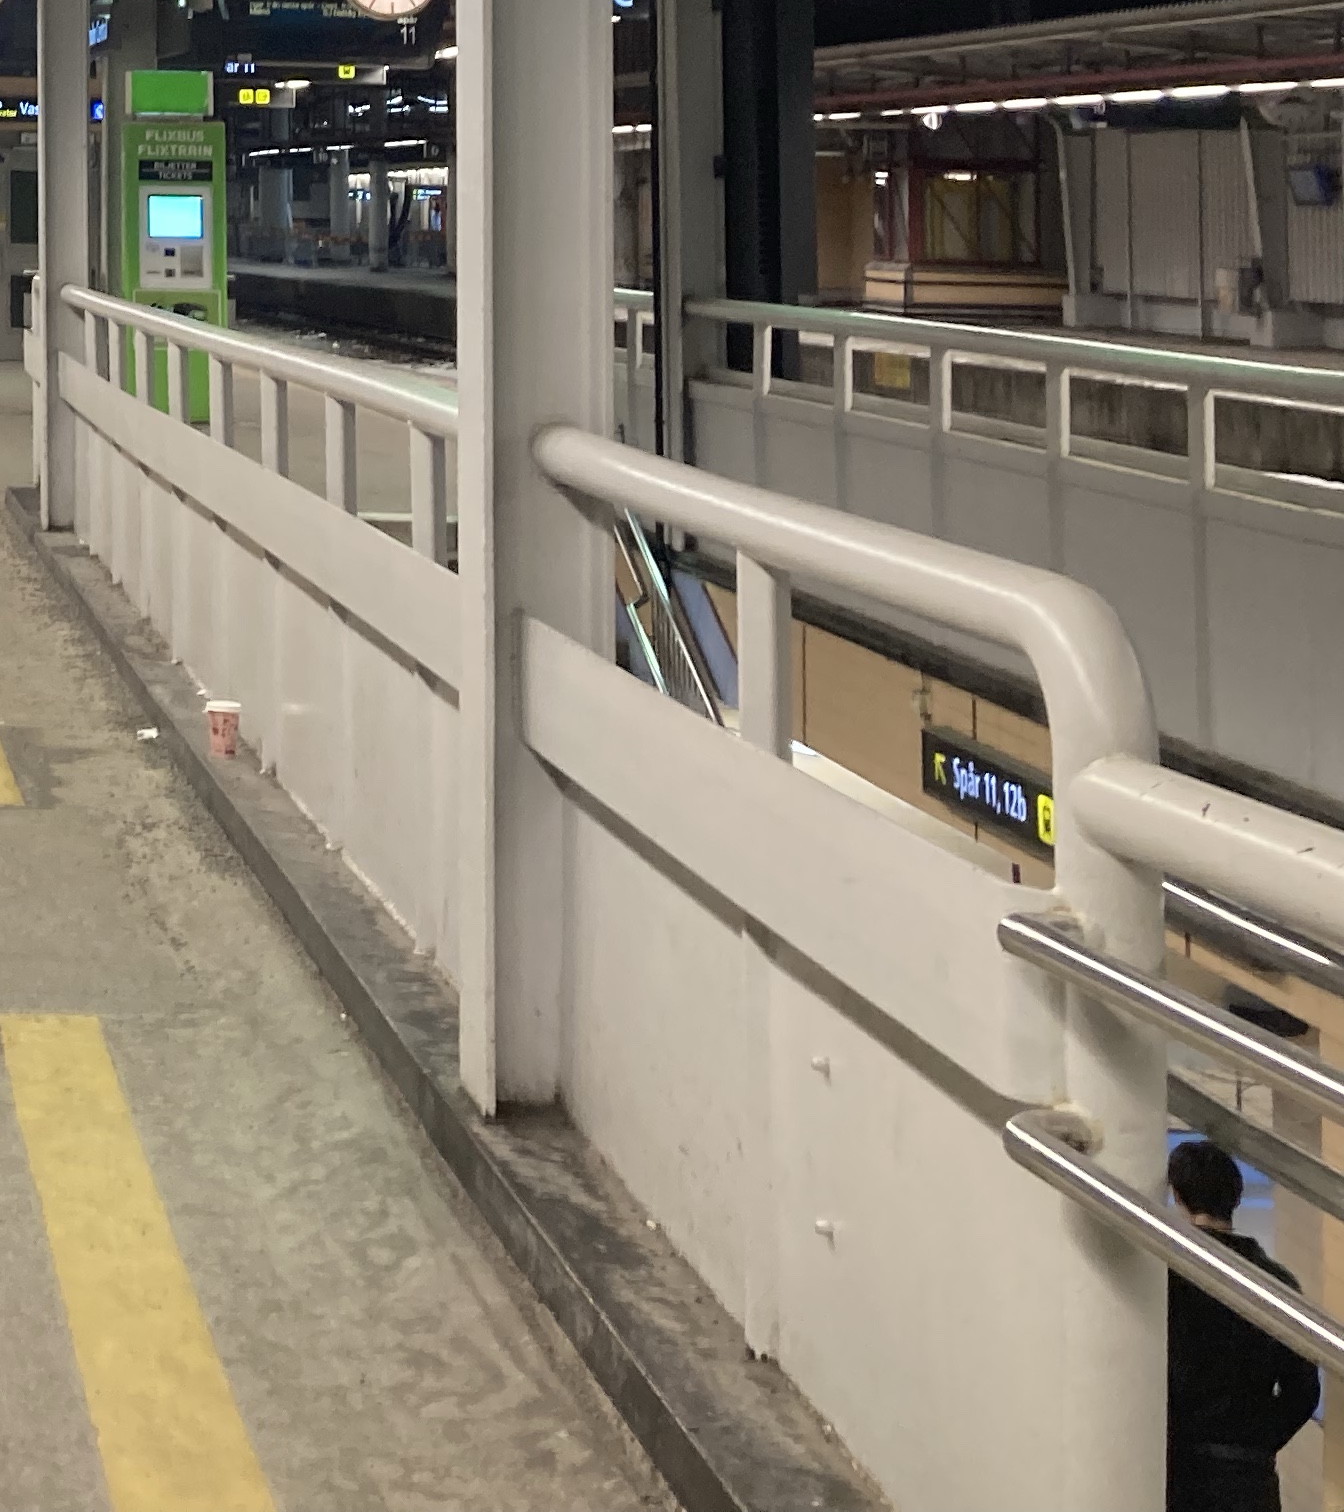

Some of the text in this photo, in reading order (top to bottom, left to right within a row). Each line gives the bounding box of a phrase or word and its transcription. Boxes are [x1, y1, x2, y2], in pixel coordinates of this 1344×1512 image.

[400, 25, 416, 45] 11
[145, 129, 204, 142] FLIXBUS
[138, 144, 213, 156] FLIXTRAIN
[158, 171, 193, 180] TICKETS
[952, 756, 1027, 822] Spår 11, 12b
